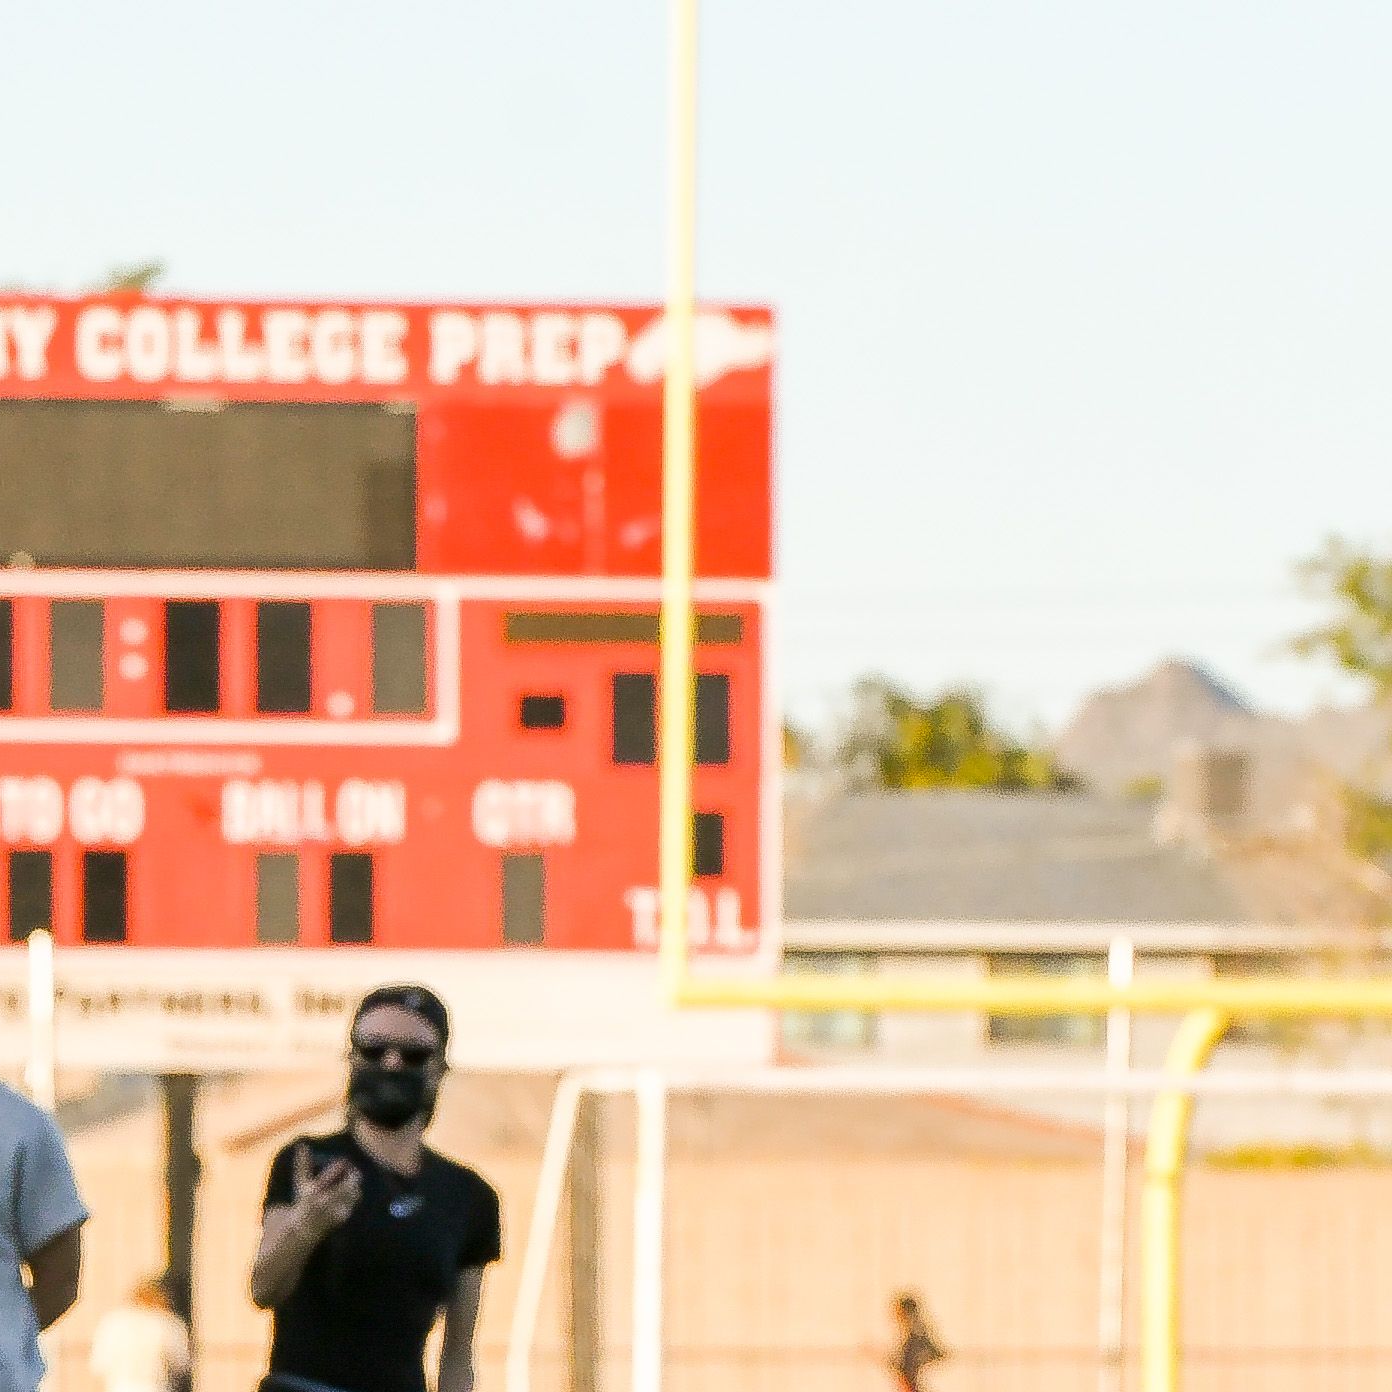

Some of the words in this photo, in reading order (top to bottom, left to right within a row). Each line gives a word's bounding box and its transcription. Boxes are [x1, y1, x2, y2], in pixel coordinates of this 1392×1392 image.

[76, 305, 409, 382] COLLEGE
[429, 309, 626, 385] PREP
[69, 776, 145, 844] GO
[222, 779, 327, 844] BALL
[336, 778, 406, 846] ON
[472, 780, 577, 846] QTR
